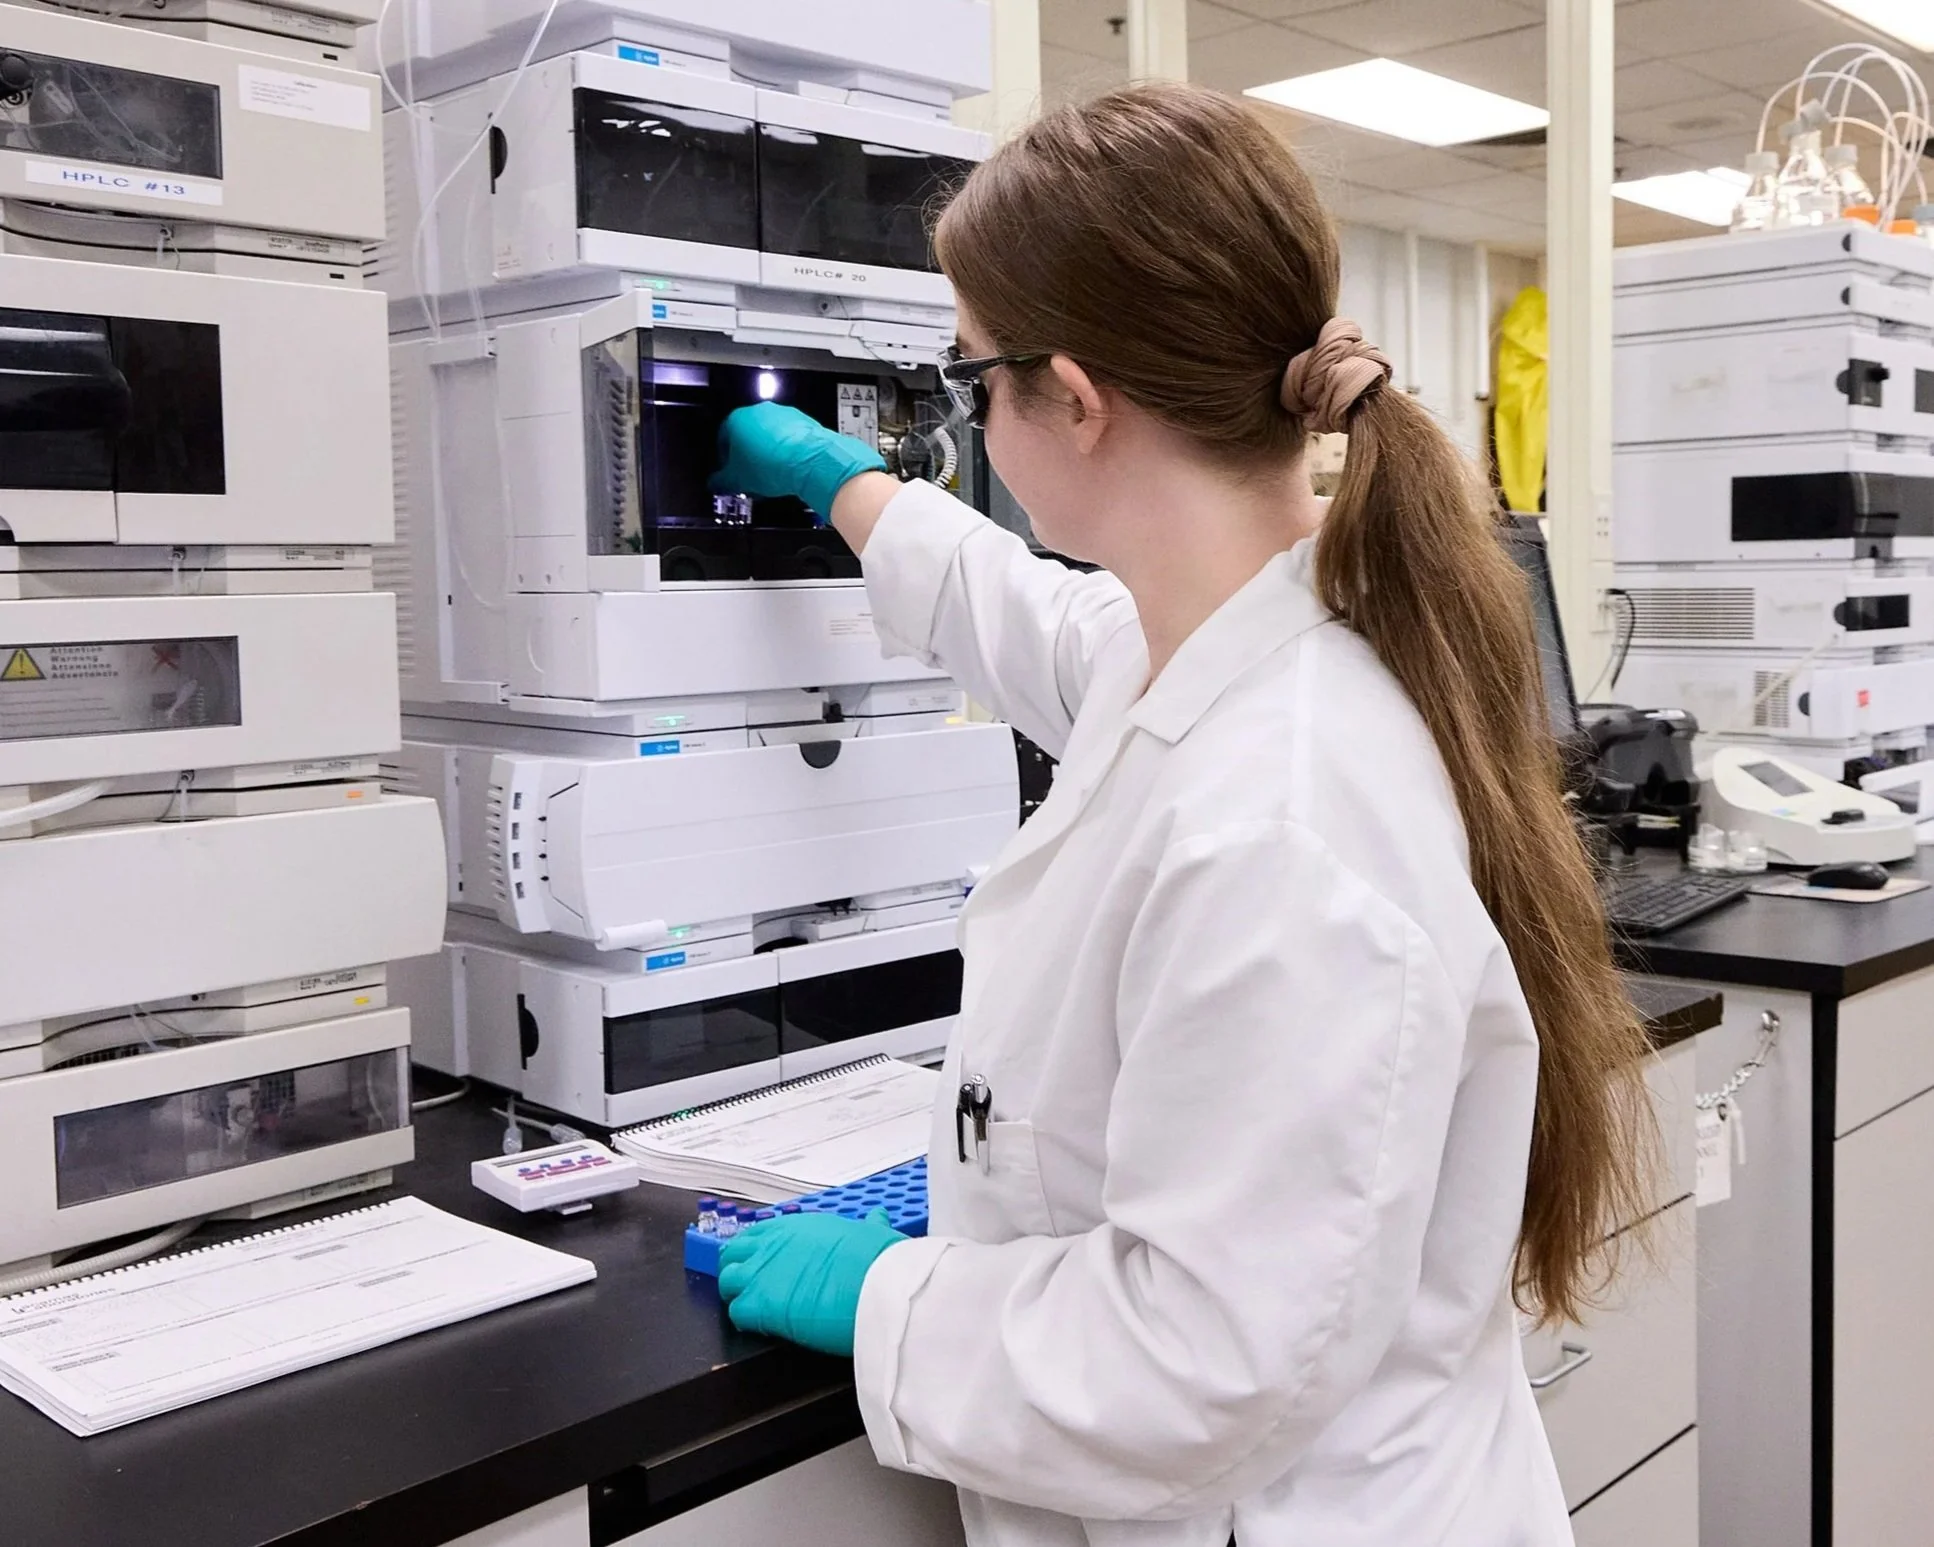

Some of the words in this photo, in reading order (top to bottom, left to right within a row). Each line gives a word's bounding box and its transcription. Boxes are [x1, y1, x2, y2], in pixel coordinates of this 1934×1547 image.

[63, 170, 130, 188] HPLC
[145, 182, 186, 196] #13
[794, 267, 843, 279] HPLC#
[851, 273, 867, 282] 20
